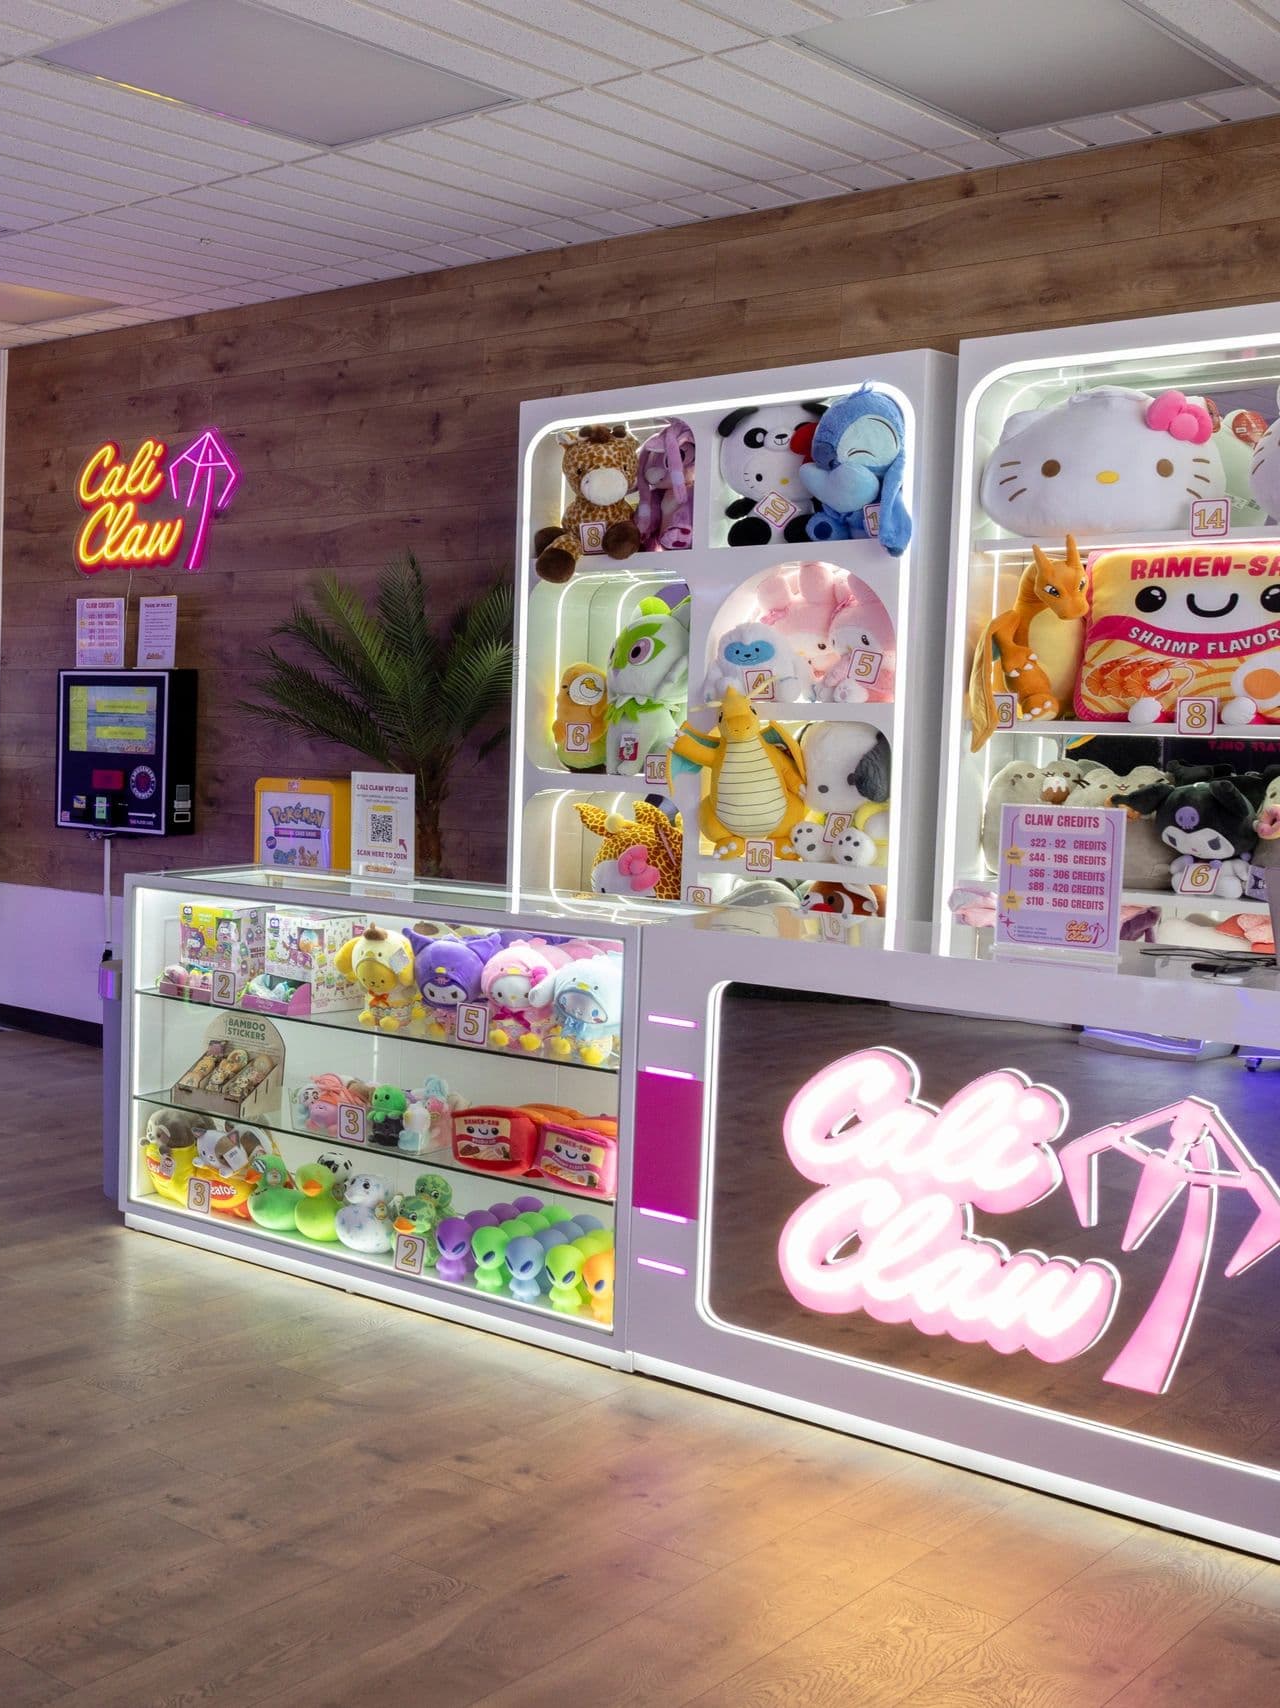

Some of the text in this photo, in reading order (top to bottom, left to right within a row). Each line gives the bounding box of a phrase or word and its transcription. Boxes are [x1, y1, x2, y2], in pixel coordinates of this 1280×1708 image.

[78, 439, 166, 506] Cali
[764, 498, 789, 522] 10
[1194, 508, 1226, 530] 14
[77, 501, 184, 568] Claw
[587, 527, 601, 547] 8
[1128, 627, 1280, 655] SHRIMP FLAVOR
[855, 653, 874, 676] 5
[752, 672, 769, 694] 4
[1186, 704, 1208, 728] 8
[572, 726, 584, 746] 6
[831, 816, 846, 838] 8
[1025, 813, 1100, 828] CLAW CREDITS
[1030, 838, 1047, 848] $22
[1054, 839, 1066, 849] 92
[1073, 840, 1107, 851] CREDITS
[748, 847, 770, 867] 16
[1029, 853, 1045, 862] $44
[1053, 854, 1068, 864] 196
[1073, 855, 1107, 866] CREDITS
[1029, 868, 1045, 878] $66
[1072, 870, 1106, 882] CREDITS
[1190, 865, 1210, 887] 6
[1028, 882, 1044, 892] $88
[1052, 883, 1069, 893] 420
[1071, 884, 1105, 896] CREDITS
[1026, 896, 1044, 906] $110
[1052, 898, 1069, 908] 560
[1071, 899, 1104, 910] CREDITS
[217, 975, 230, 998] 2
[227, 1027, 266, 1041] STICKERS
[228, 1018, 266, 1032] BAMBOO
[463, 1010, 479, 1036] 5
[345, 1109, 359, 1134] 3
[783, 1046, 1069, 1214] Cali
[192, 1182, 206, 1207] 3
[401, 1239, 417, 1267] 2
[778, 1175, 1121, 1364] Claw
